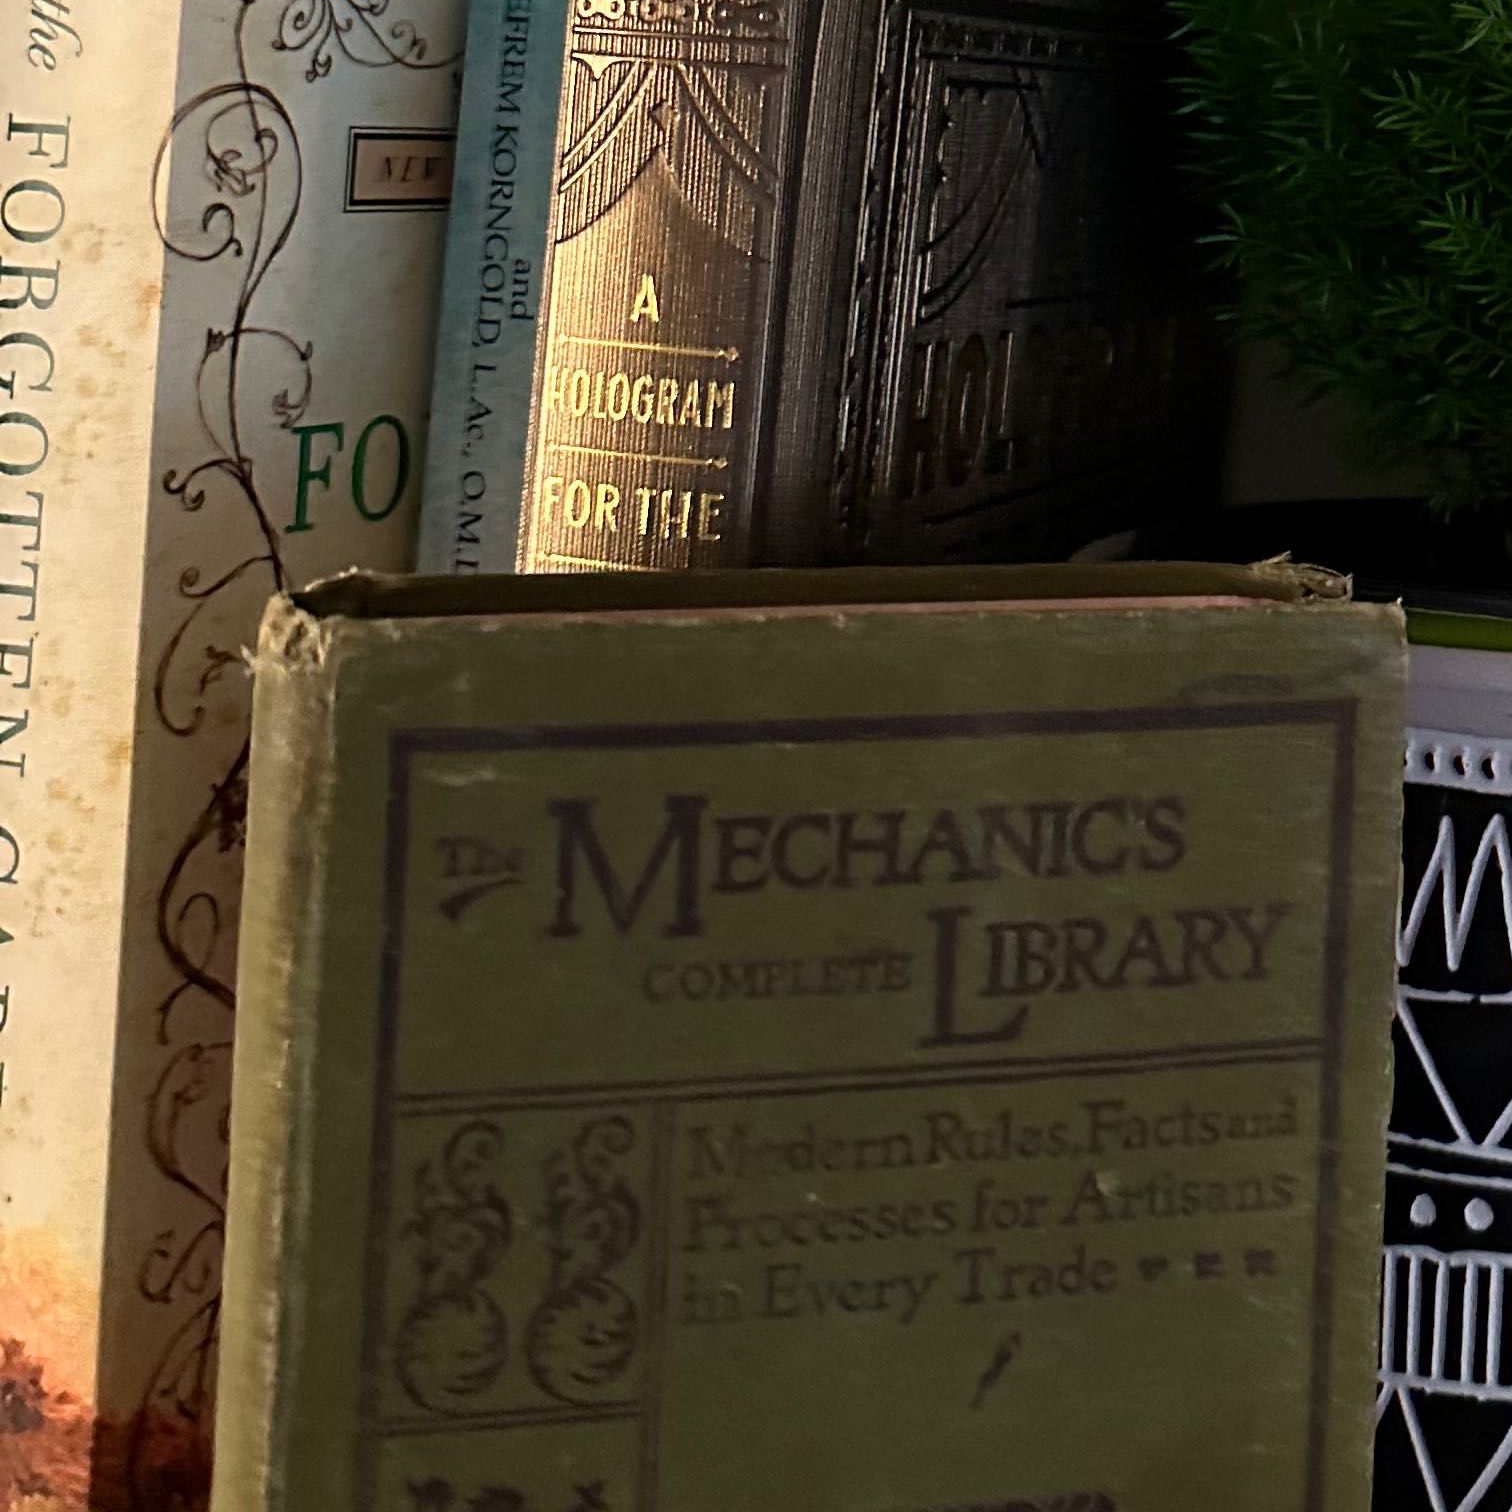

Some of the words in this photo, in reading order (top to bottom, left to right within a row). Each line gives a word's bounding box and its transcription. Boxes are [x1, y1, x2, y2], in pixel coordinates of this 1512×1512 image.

[471, 125, 519, 348] KORNGOLD,
[511, 258, 534, 321] and
[629, 273, 661, 323] A
[550, 364, 736, 430] HOLOGRAM
[543, 475, 621, 534] FOR
[635, 487, 726, 541] THE
[434, 834, 528, 880] The
[641, 949, 915, 1004] COMPLETE
[919, 900, 1295, 1049] LIBRARY
[687, 1122, 915, 1179] Modern
[1082, 1099, 1221, 1154] Facts
[1226, 1096, 1297, 1138] and
[682, 1193, 958, 1253] Processes
[972, 1179, 1050, 1232] for
[1060, 1168, 1297, 1226] Artisans
[684, 1275, 739, 1326] in
[762, 1262, 938, 1324] Every
[953, 1245, 1119, 1306] Trade
